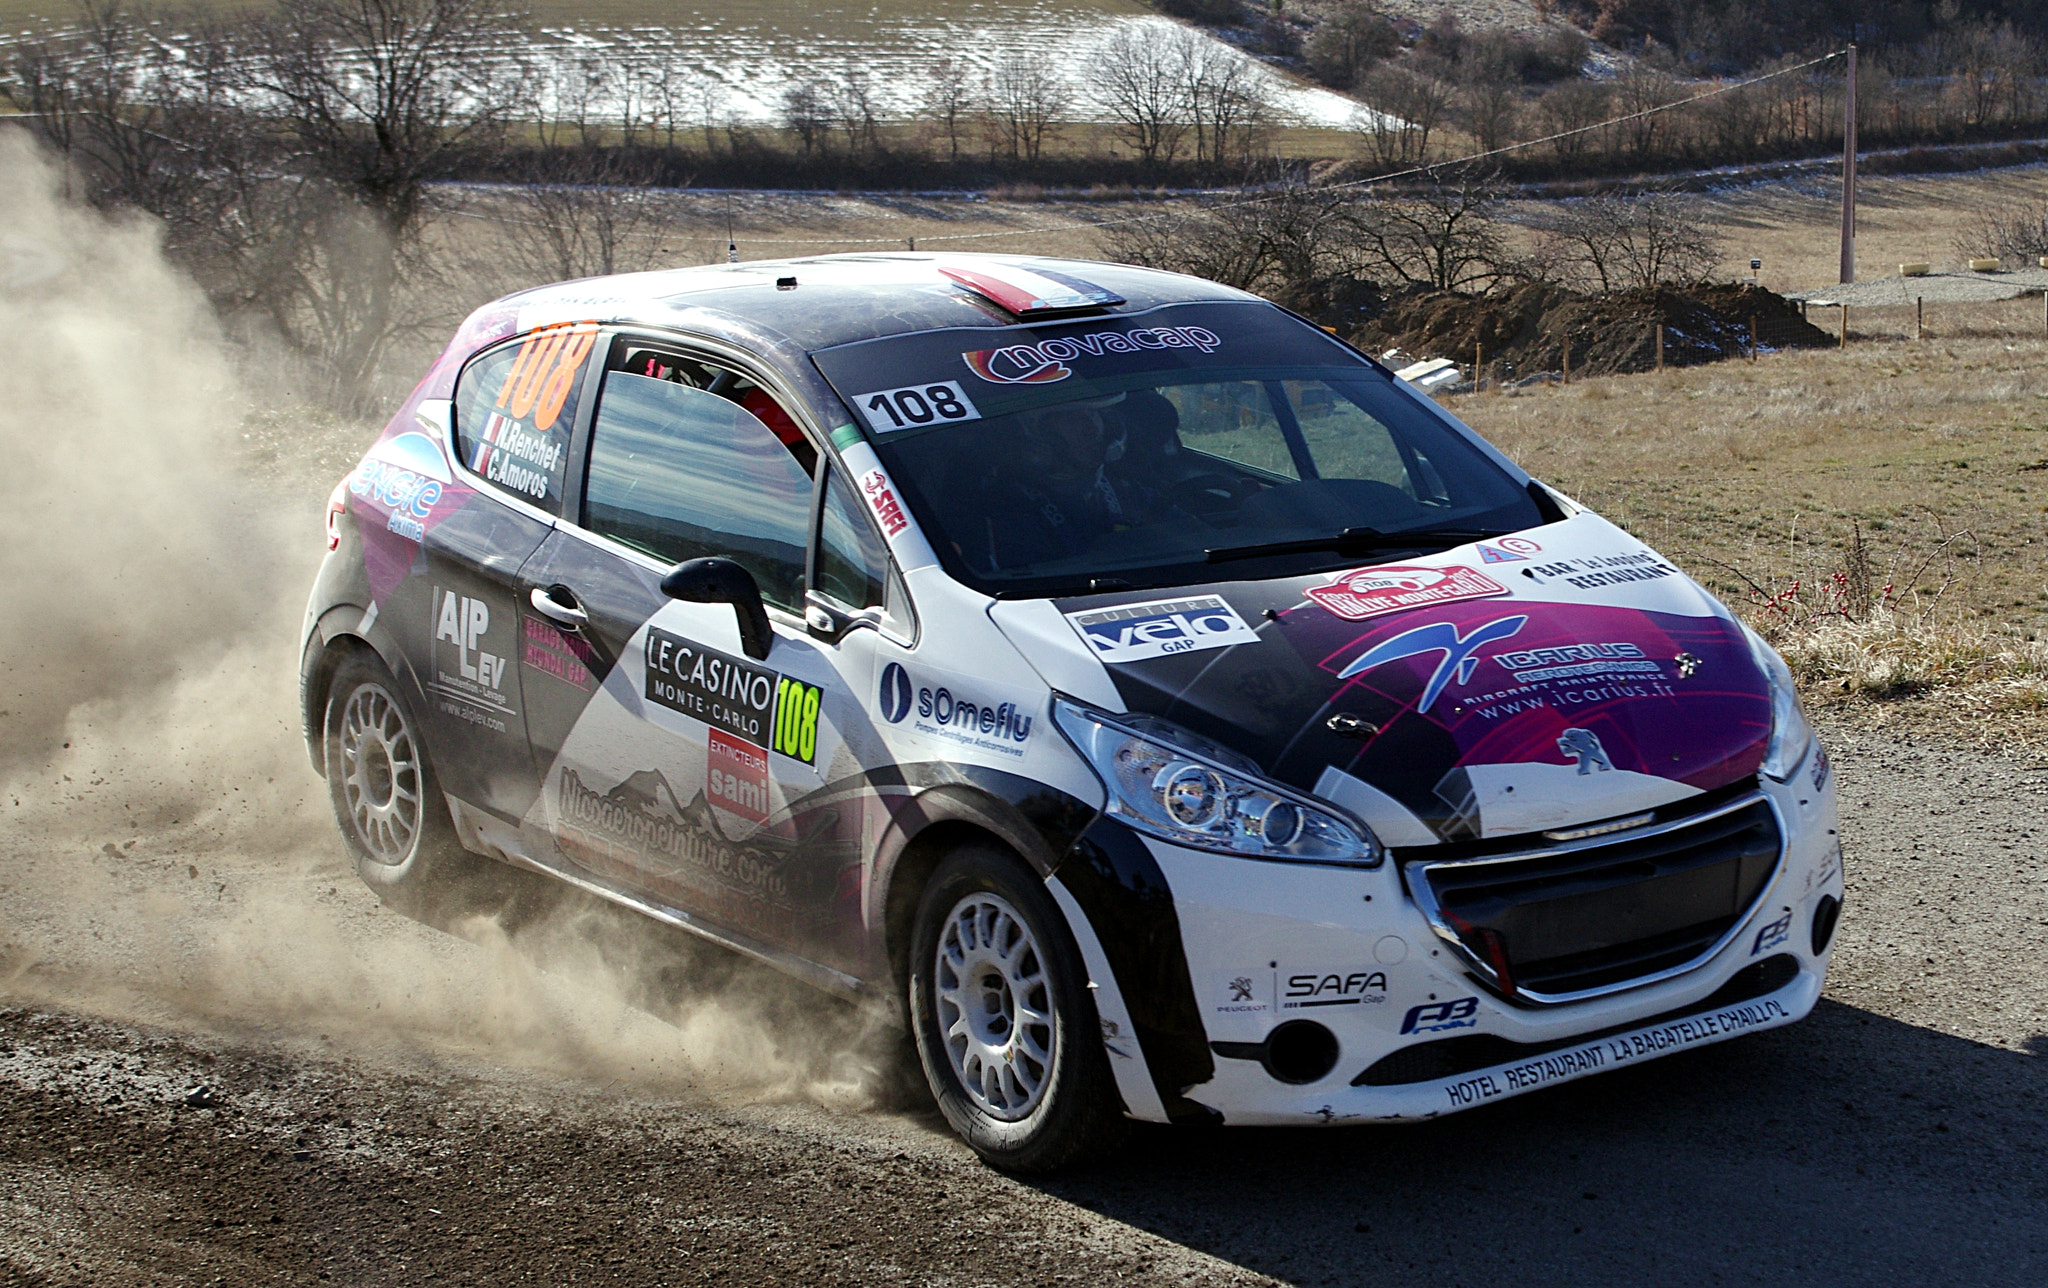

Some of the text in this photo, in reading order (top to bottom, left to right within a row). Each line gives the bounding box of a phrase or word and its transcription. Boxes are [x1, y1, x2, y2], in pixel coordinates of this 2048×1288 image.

[1002, 326, 1222, 369] novacap
[495, 319, 598, 431] 108
[868, 385, 967, 427] 108
[497, 417, 562, 472] N.Renchet
[486, 452, 549, 500] C.Amoros
[1532, 562, 1580, 577] BAR
[1566, 563, 1678, 589] RESTAURANT
[1363, 580, 1394, 588] 108
[1078, 599, 1223, 626] CULTURE
[1331, 594, 1399, 617] RALLYE
[1161, 639, 1195, 653] GAP
[1493, 643, 1647, 669] ICARIUS
[1513, 661, 1661, 683] AEROTECHNICS
[1463, 683, 1549, 704] AIRCRAFT
[774, 677, 820, 762] 108
[711, 739, 767, 774] EXTINCTEURS
[710, 768, 768, 814] sami
[1285, 972, 1388, 997] SAFA
[1217, 1004, 1268, 1013] PEUGEOT
[1445, 1075, 1502, 1106] HOTEL
[1505, 1045, 1605, 1090] RESTAURANT
[1608, 1041, 1634, 1061] LA
[1634, 1016, 1720, 1056] BAGATELLE
